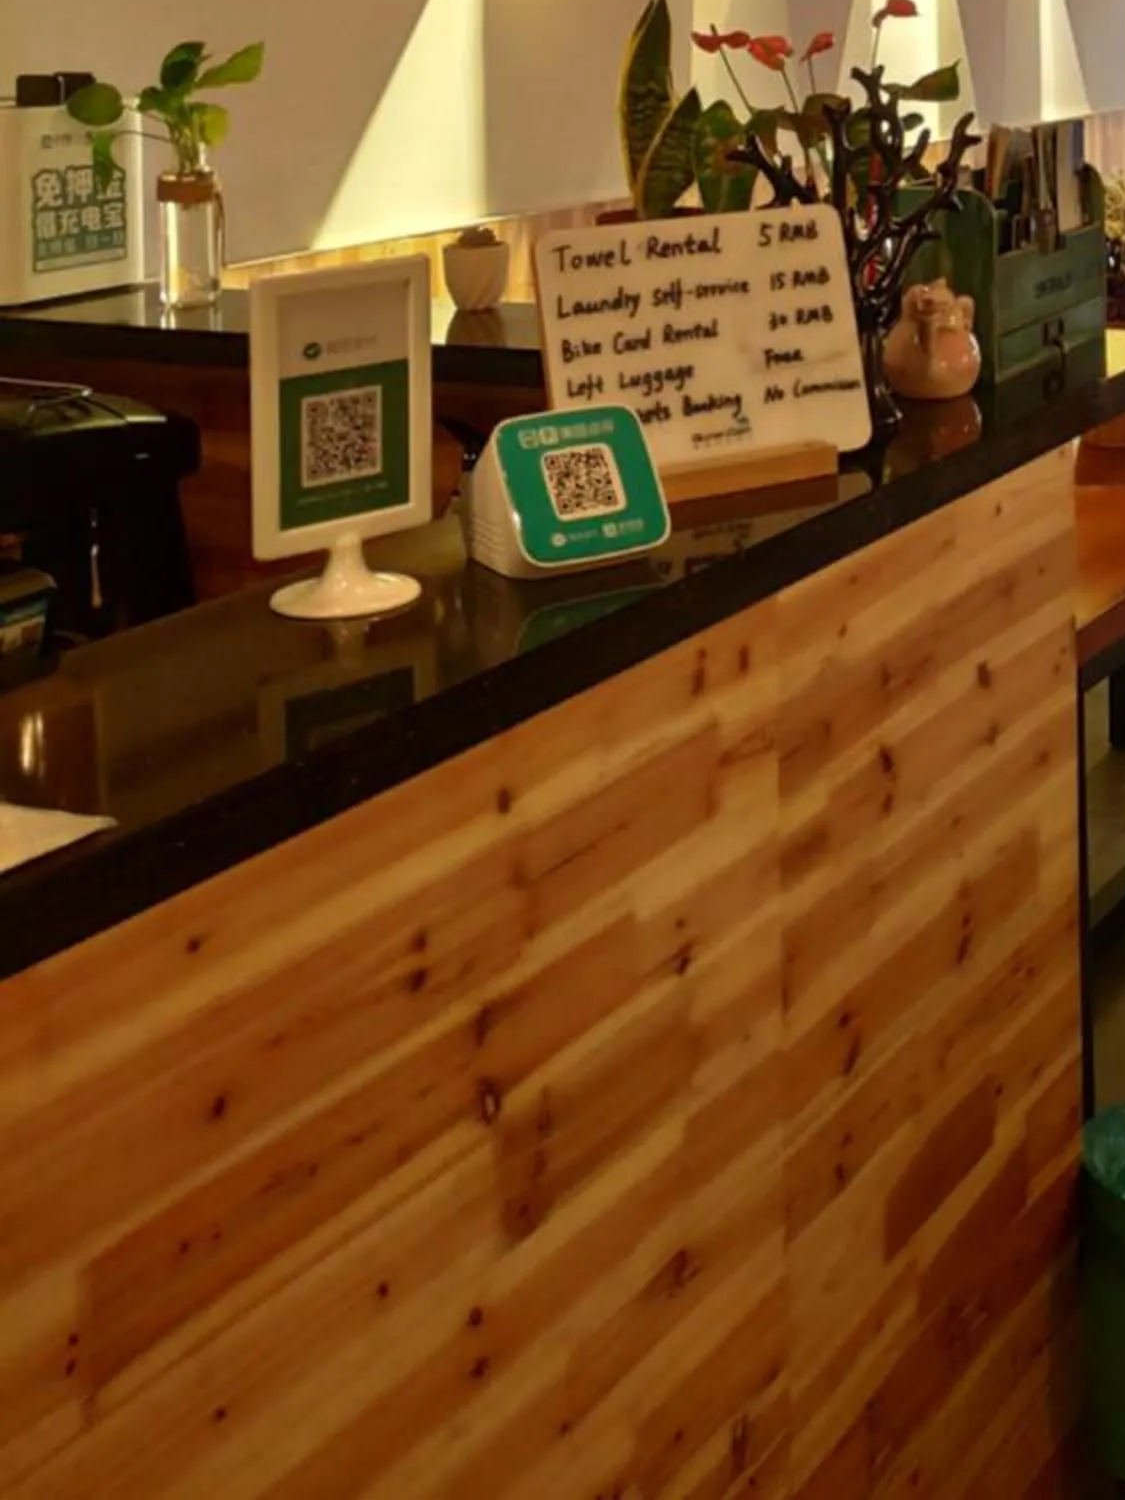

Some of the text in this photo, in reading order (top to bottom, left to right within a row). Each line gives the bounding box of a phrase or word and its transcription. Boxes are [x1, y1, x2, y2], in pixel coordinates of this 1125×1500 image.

[553, 219, 818, 272] Towel Rental 5 RMB
[558, 286, 640, 319] Laundry
[769, 271, 786, 292] 15
[792, 266, 830, 290] RMB
[562, 339, 602, 364] Bike
[612, 328, 651, 355] Card
[663, 318, 719, 344] Rental
[796, 304, 833, 326] RMB
[567, 348, 804, 401] Left Luggage Free
[764, 384, 785, 406] No
